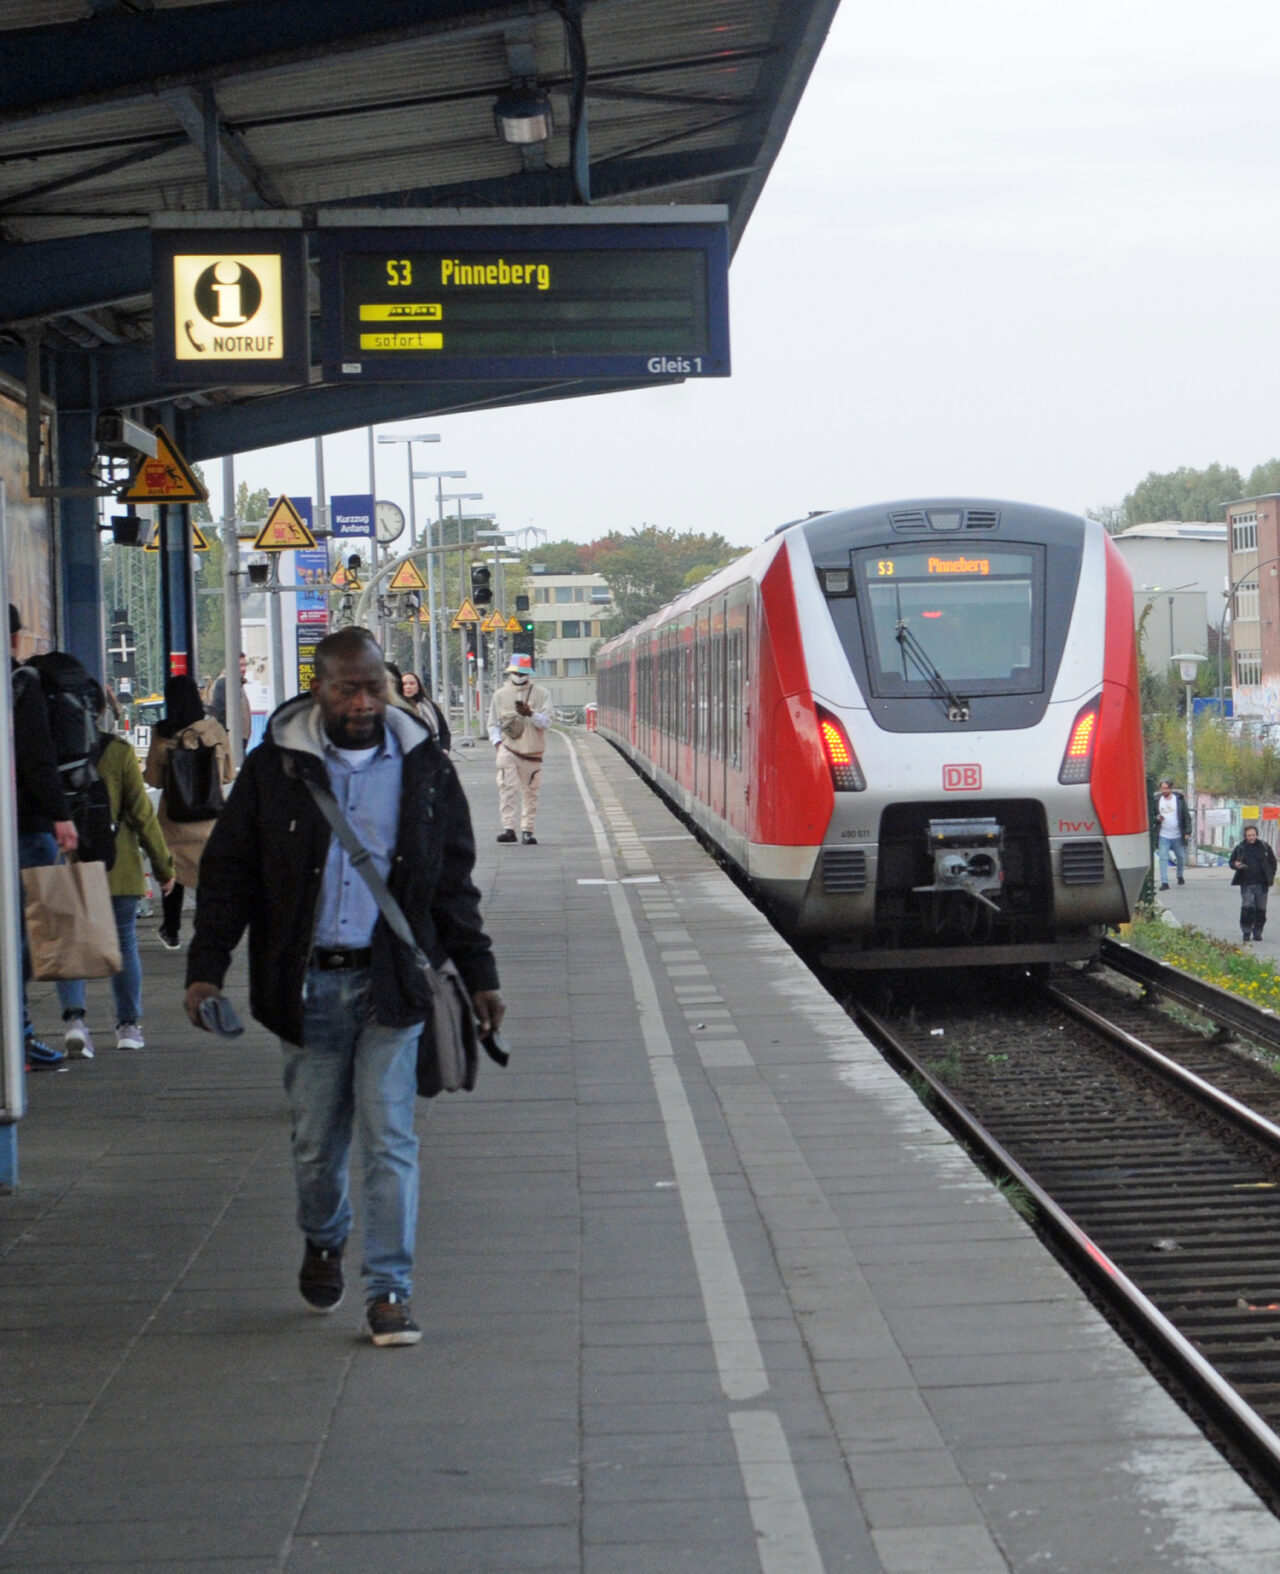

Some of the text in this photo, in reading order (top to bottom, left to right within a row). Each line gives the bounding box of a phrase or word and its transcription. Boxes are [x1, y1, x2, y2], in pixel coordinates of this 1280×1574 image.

[386, 259, 550, 290] S3 Pinneberg
[213, 336, 275, 352] NOTRUF
[375, 333, 424, 348] sofort
[647, 357, 702, 373] Gleis 1
[336, 515, 369, 524] Kurzzug
[341, 524, 370, 534] Anfang
[878, 557, 989, 575] S3 Pinneberg
[137, 728, 148, 746] H
[946, 767, 978, 787] DB
[1058, 819, 1095, 833] hvv
